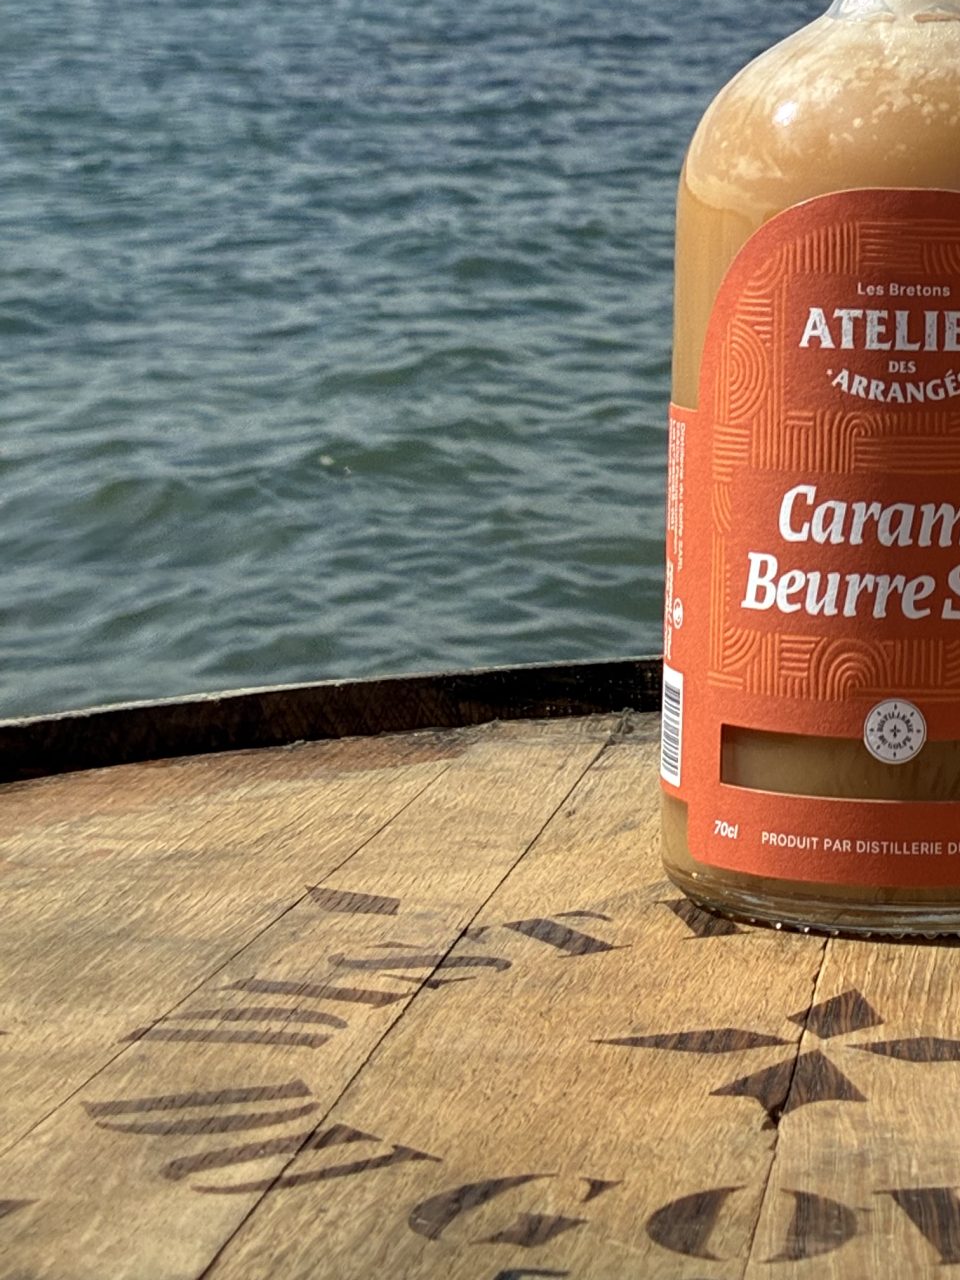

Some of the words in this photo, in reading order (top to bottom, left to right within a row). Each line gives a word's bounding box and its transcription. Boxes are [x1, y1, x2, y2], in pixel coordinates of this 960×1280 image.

[857, 282, 884, 296] Les
[889, 282, 950, 297] Bretons
[888, 360, 916, 373] DES
[741, 552, 936, 620] Beurre
[713, 820, 738, 840] 70cl
[761, 831, 819, 851] PRODUIT
[823, 838, 852, 853] PAR
[856, 840, 943, 856] DISTILLERIE
